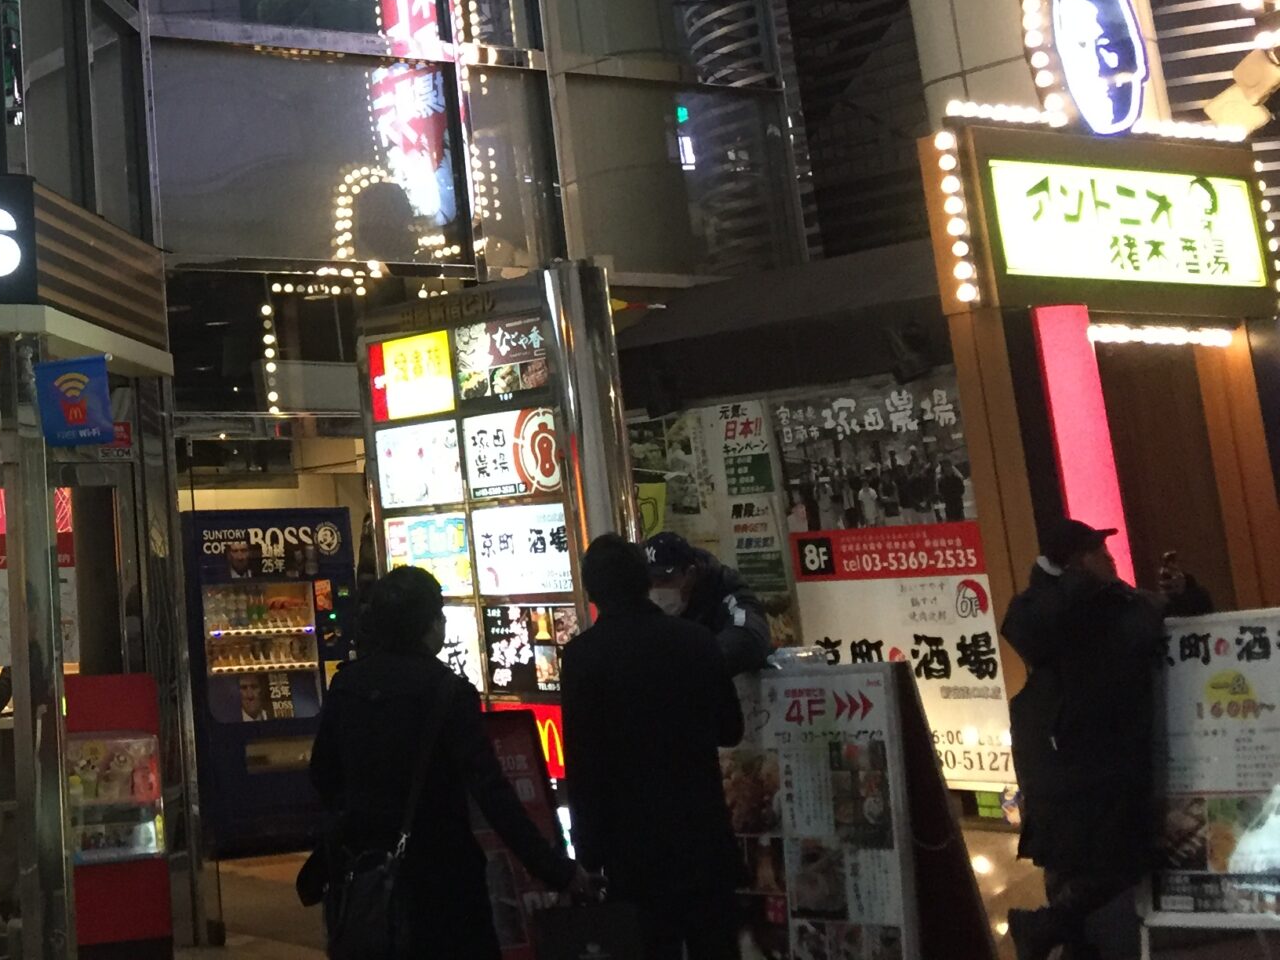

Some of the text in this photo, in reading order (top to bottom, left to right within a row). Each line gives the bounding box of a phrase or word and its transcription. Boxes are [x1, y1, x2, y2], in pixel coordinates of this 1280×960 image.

[202, 529, 246, 541] SUNTORY
[247, 525, 314, 546] BOSS
[261, 558, 286, 573] 25年
[804, 543, 829, 572] 8F
[785, 698, 827, 727] 4F
